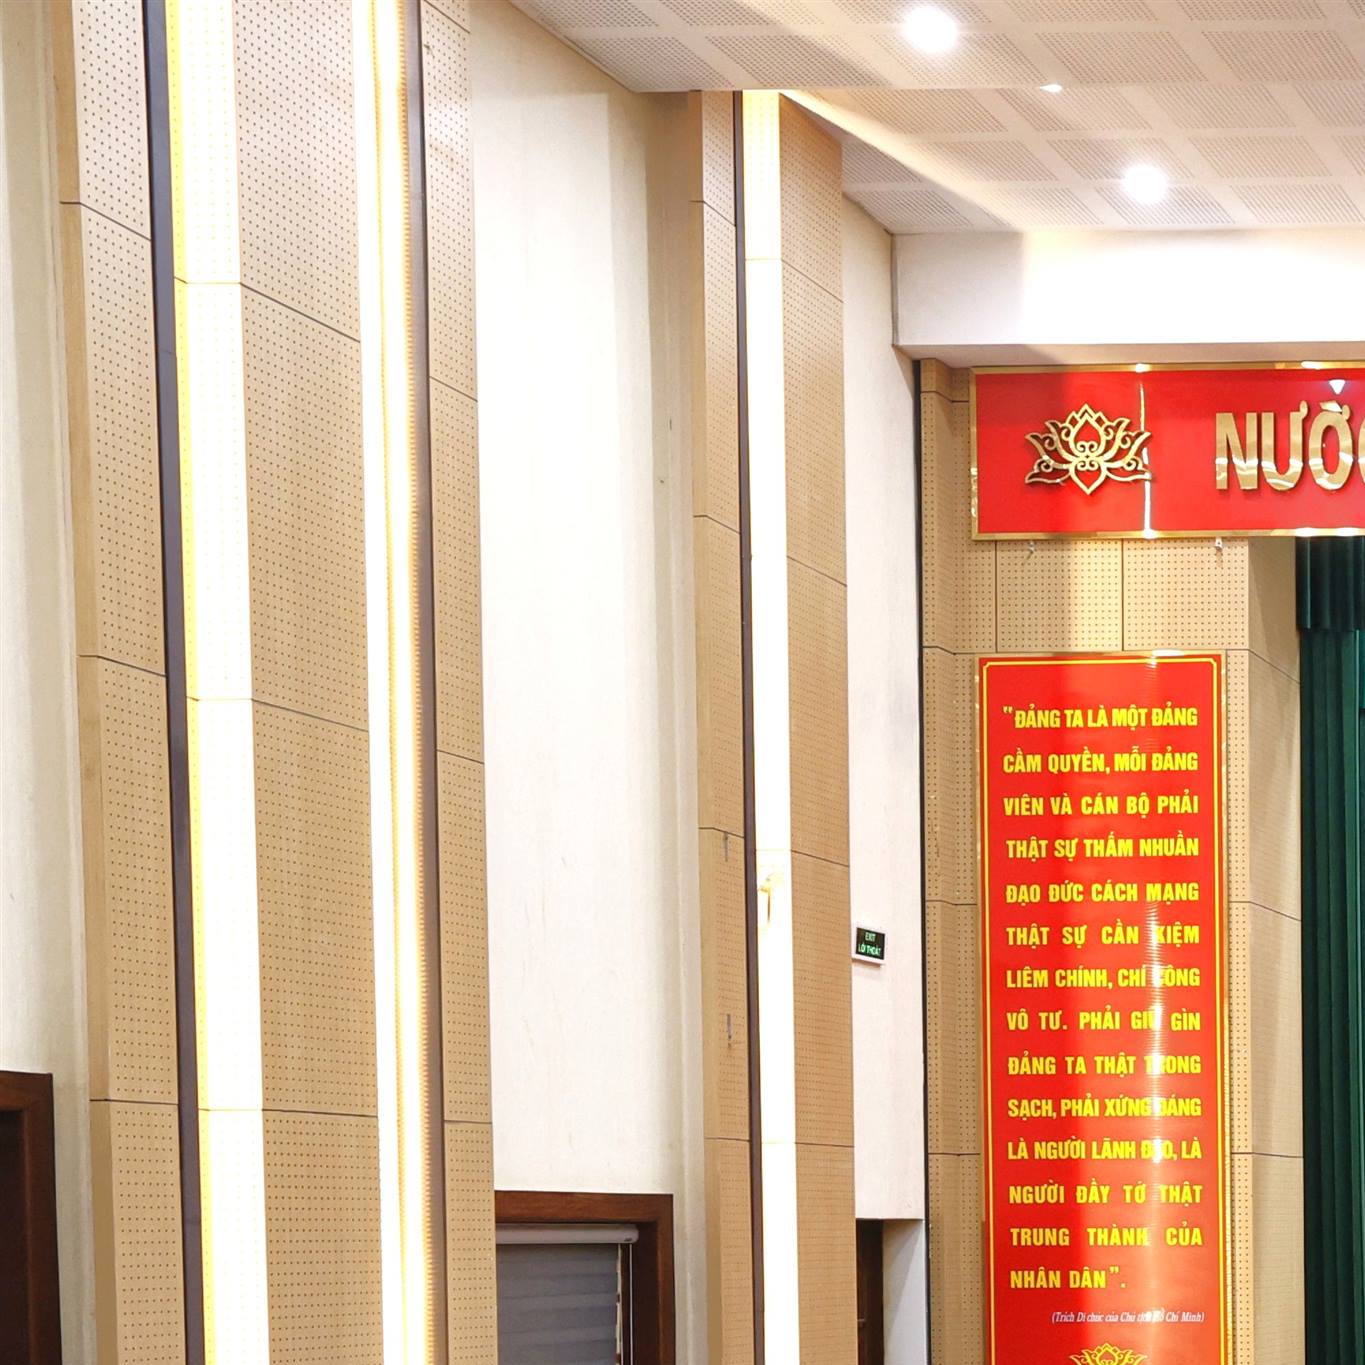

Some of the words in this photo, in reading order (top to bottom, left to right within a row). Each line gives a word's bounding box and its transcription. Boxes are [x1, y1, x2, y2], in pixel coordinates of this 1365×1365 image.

[1064, 710, 1084, 727] TA
[1088, 705, 1108, 727] LÀ
[1112, 705, 1148, 730] MỘT
[1151, 702, 1197, 726] ĐẢNG
[1004, 748, 1041, 773] CẦM
[1049, 746, 1110, 774] QUYỀN,
[1152, 746, 1198, 771] ĐẢNG
[1004, 794, 1043, 815] VIÊN
[1050, 793, 1072, 815] VÀ
[1081, 793, 1118, 814] CÁN
[1127, 793, 1149, 818] BỘ
[1158, 789, 1198, 813] PHẢI
[1006, 836, 1048, 861] THẬT
[1055, 838, 1078, 861] SỰ
[1084, 832, 1133, 857] THẤM
[1140, 831, 1199, 856] NHUẦN
[1006, 885, 1040, 905] ĐẠO
[1049, 880, 1084, 902] ĐỨC
[1092, 880, 1138, 901] CÁCH
[1146, 883, 1199, 904] MẠNG
[1006, 923, 1049, 948] THẬT
[1063, 925, 1087, 948] SỰ
[1007, 966, 1048, 987] LIÊM
[1056, 966, 1113, 989] CHÍNH,
[1007, 1009, 1028, 1030] VÔ
[1039, 1011, 1067, 1030] TƯ.
[1080, 1005, 1120, 1029] PHẢI
[1171, 1008, 1200, 1031] GÌN
[1008, 1051, 1056, 1074] ĐẢNG
[1065, 1056, 1087, 1074] TA
[1094, 1052, 1136, 1077] THẬT
[1008, 1099, 1056, 1120] SẠCH,
[1061, 1093, 1100, 1117] PHẢI
[1008, 1138, 1028, 1159] LÀ
[1034, 1136, 1088, 1159] NGƯỜI
[1092, 1138, 1136, 1159] LÃNH
[1182, 1137, 1201, 1158] LÀ
[1010, 1180, 1064, 1203] NGƯỜI
[1123, 1181, 1147, 1203] TỚ
[1011, 1228, 1069, 1245] TRUNG
[1166, 1221, 1202, 1245] CỦA
[1011, 1267, 1060, 1288] NHÂN
